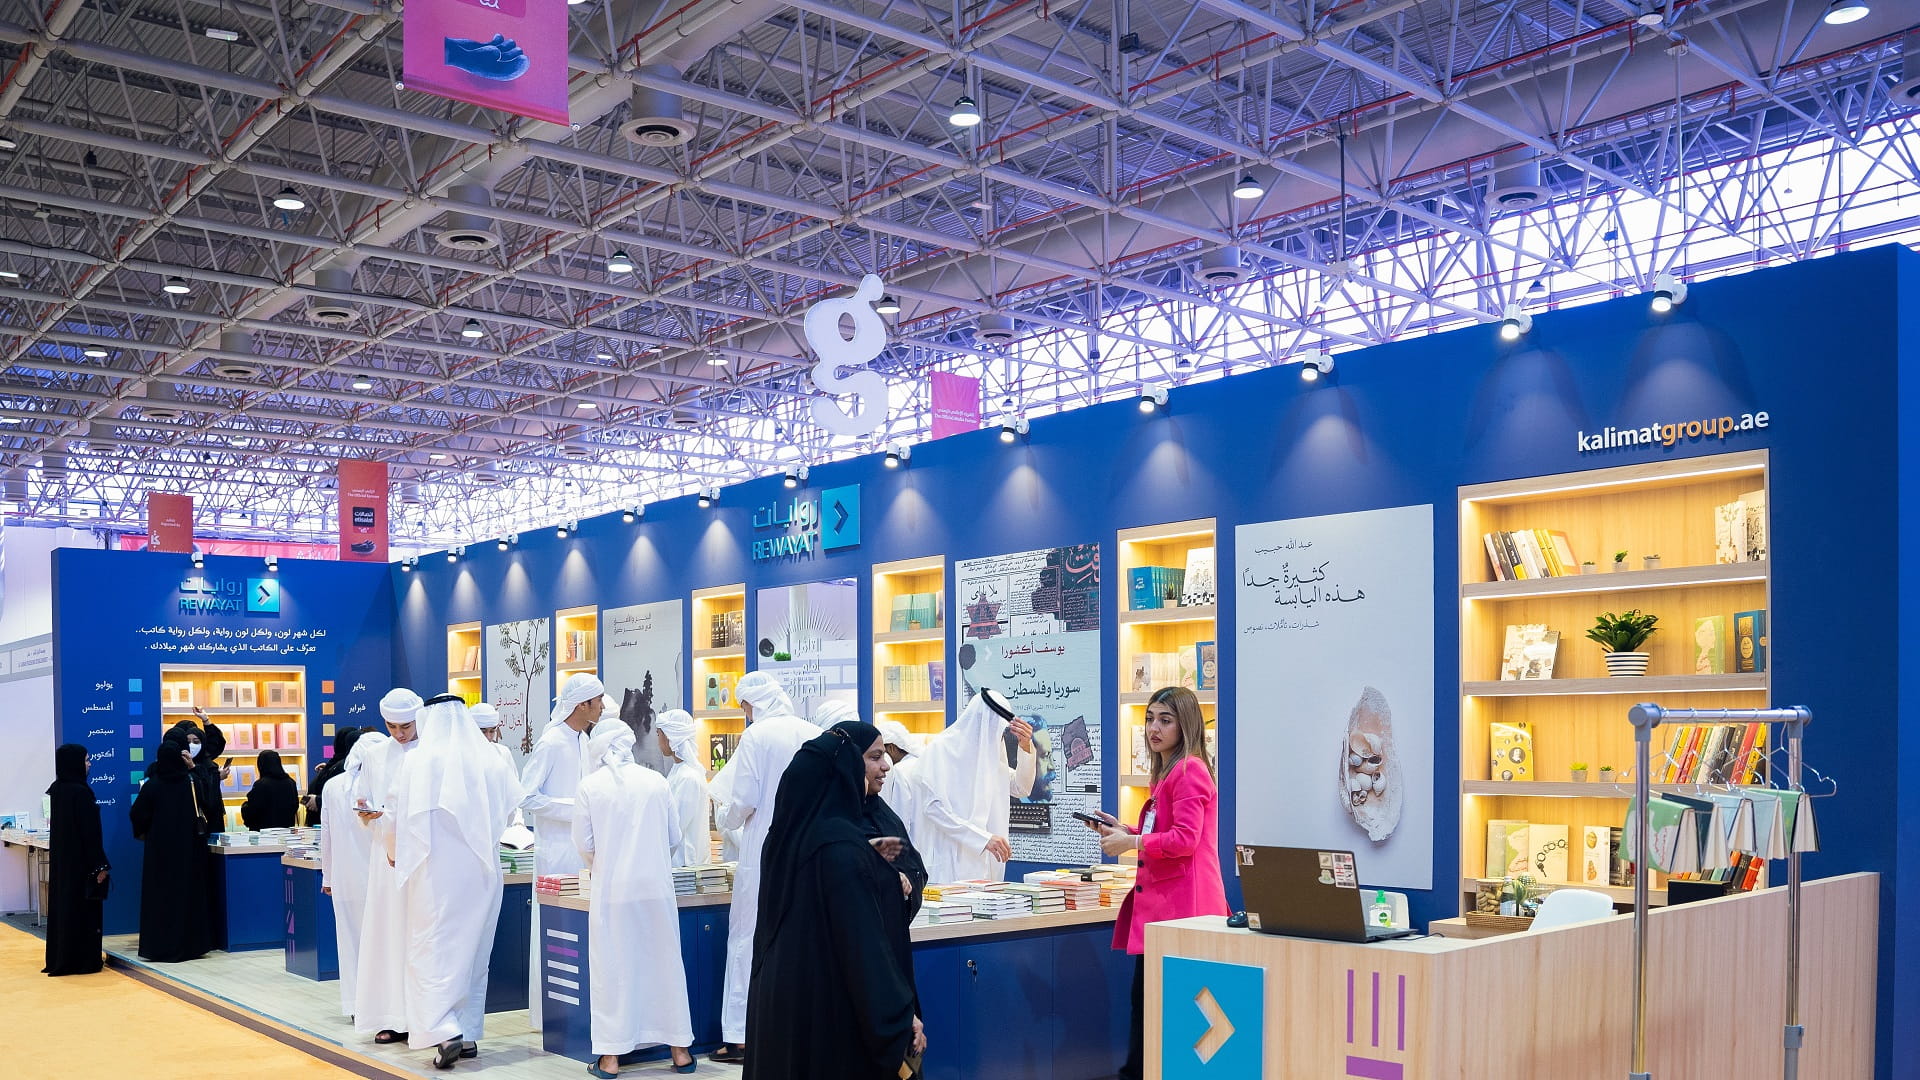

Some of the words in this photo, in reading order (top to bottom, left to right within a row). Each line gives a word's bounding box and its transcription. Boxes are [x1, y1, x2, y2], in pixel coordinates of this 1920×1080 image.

[1577, 410, 1770, 452] kalimatgroup.ae
[752, 496, 818, 529] روايات
[752, 531, 819, 560] REWAYAT
[180, 576, 242, 596] روايات
[1274, 585, 1321, 609] اليابسة
[1325, 584, 1366, 602] هذه
[180, 598, 243, 610] REWAYAT
[168, 625, 186, 638] رواية
[188, 626, 211, 638] ولكل
[234, 627, 249, 638] لون
[250, 627, 273, 639] ولكل
[292, 629, 308, 640] شهر
[309, 629, 326, 639] لكل
[150, 641, 177, 652] ميلادك
[178, 642, 195, 654] شهر
[197, 642, 229, 654] يشاركك
[229, 642, 248, 655] الذي
[249, 643, 278, 654] الكاتب
[280, 643, 295, 655] على
[1001, 640, 1035, 659] أكشورا
[1035, 642, 1065, 656] يوسف
[1001, 662, 1037, 679] رسائل
[95, 680, 114, 691] يوليو
[351, 682, 366, 693] يناير
[1002, 680, 1052, 700] وفلسطين
[1053, 680, 1081, 700] سوريا
[82, 701, 114, 714] أغسطس
[348, 703, 366, 714] فبراير
[87, 727, 114, 738] سبتمبر
[90, 748, 115, 761] أكتوبر
[90, 774, 115, 785] نوفمبر
[95, 797, 116, 806] ديسم
